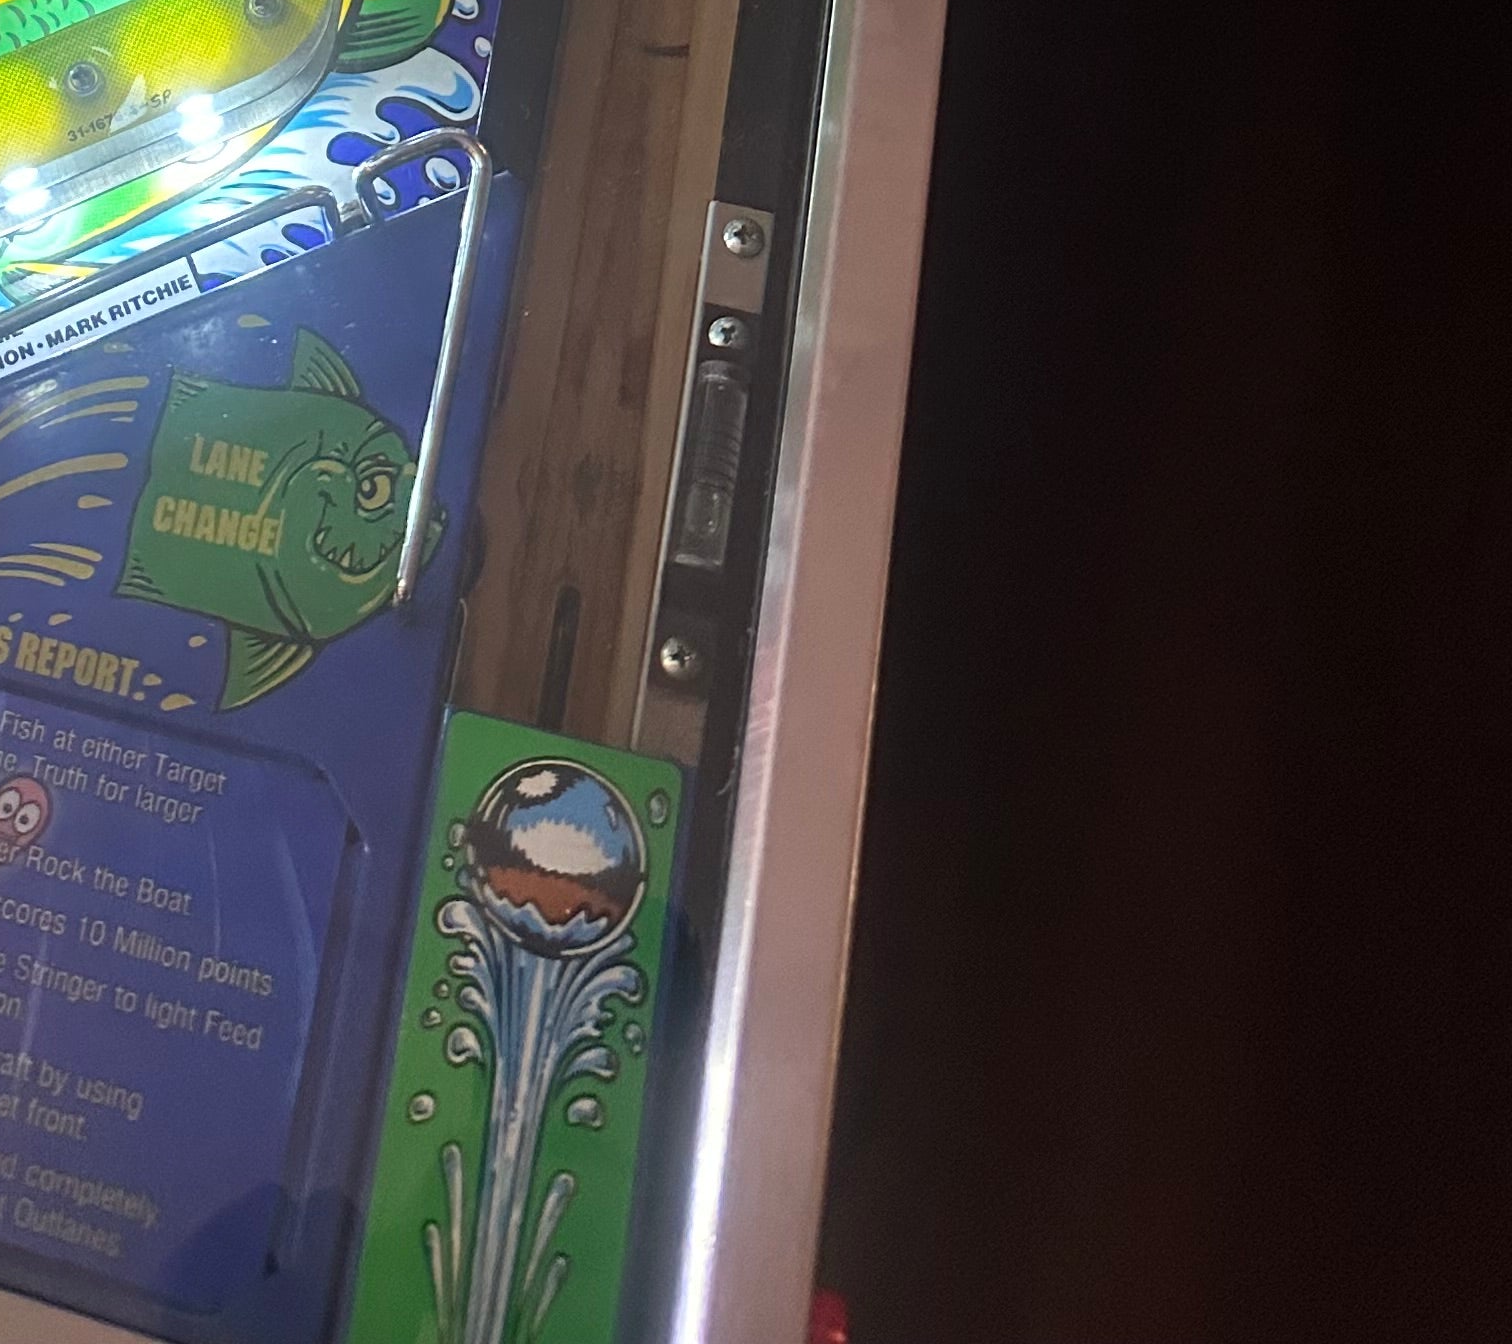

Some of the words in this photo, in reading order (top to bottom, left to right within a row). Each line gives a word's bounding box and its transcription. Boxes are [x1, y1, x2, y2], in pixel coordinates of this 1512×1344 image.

[45, 311, 108, 349] MARK
[108, 274, 194, 321] RITCHIE
[190, 434, 269, 487] LANE
[152, 495, 281, 557] CHANGE
[0, 709, 46, 743] Fish
[54, 728, 74, 753] at
[82, 735, 148, 770] either
[154, 751, 227, 796] Target
[31, 753, 89, 792] Truth
[96, 773, 130, 804] for
[135, 785, 204, 825] larger
[26, 845, 86, 885] Rock
[92, 866, 129, 898] the
[78, 915, 106, 947] 10
[113, 925, 192, 972] Million
[13, 953, 107, 1004] Stringer
[113, 984, 138, 1013] to
[144, 990, 197, 1030] light
[203, 1011, 264, 1051] Feed
